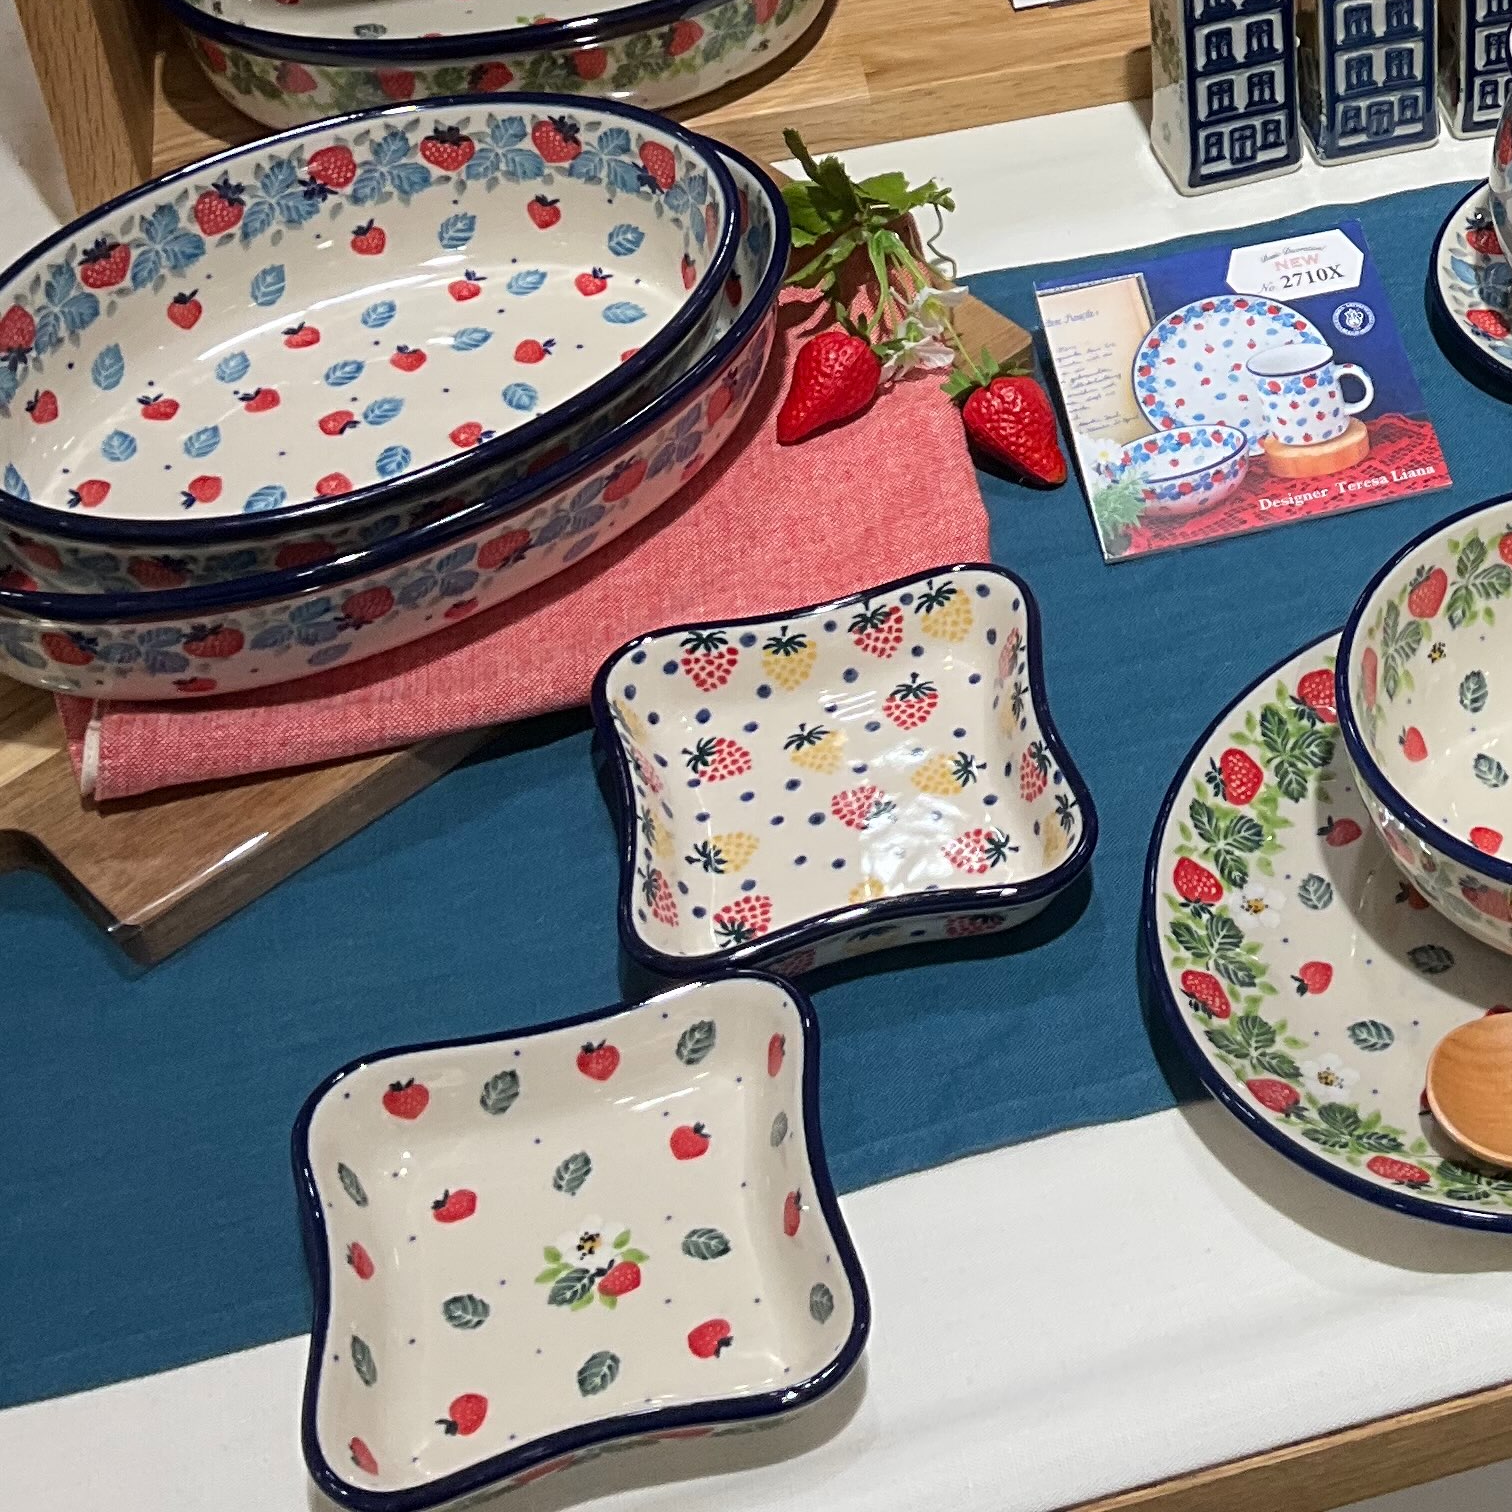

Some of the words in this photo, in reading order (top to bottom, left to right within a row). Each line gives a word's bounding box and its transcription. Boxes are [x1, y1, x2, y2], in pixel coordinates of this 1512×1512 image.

[1274, 253, 1320, 272] NEW
[1280, 263, 1345, 289] 2710X
[1258, 488, 1329, 511] Designer
[1335, 476, 1389, 494] Teresa
[1390, 465, 1436, 483] Liana
